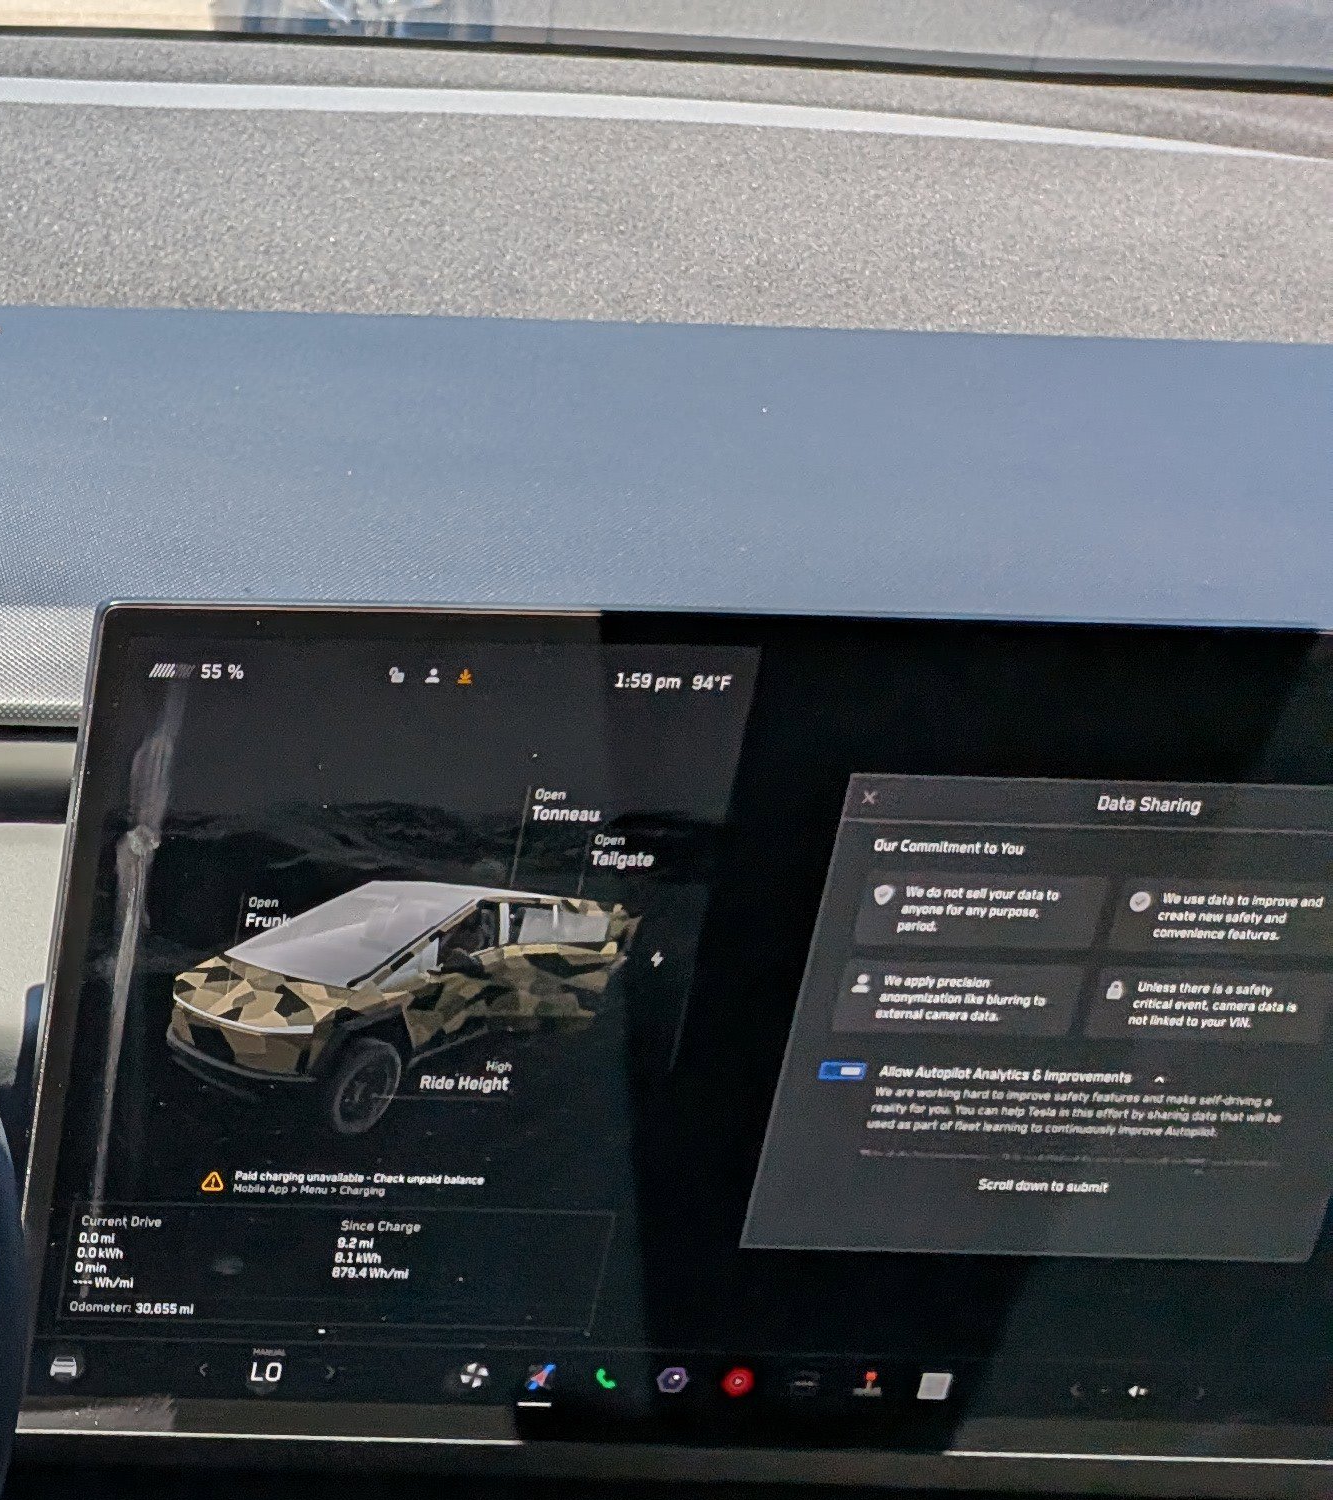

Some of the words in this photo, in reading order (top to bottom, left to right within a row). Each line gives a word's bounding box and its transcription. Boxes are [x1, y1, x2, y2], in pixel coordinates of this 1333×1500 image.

[200, 663, 222, 680] 55
[227, 663, 244, 680] %
[614, 672, 652, 689] 1:59
[654, 676, 682, 692] pm
[692, 674, 732, 691] 94°F
[534, 788, 567, 802] Open
[1096, 794, 1136, 812] Data
[1139, 796, 1202, 816] Sharing
[532, 805, 601, 822] Tonneau
[594, 834, 626, 848] Open
[874, 838, 899, 852] Our
[900, 839, 982, 854] Commitment
[984, 842, 998, 854] to
[1000, 842, 1026, 855] You
[591, 850, 655, 870] Tailgate
[906, 886, 924, 898] We
[926, 887, 942, 898] do
[943, 887, 964, 899] not
[965, 887, 988, 899] sell
[989, 889, 1016, 901] your
[1017, 889, 1044, 901] data
[1046, 890, 1060, 901] to
[1163, 893, 1182, 905] We
[1183, 894, 1206, 905] use
[1207, 894, 1234, 906] data
[1237, 895, 1250, 906] to
[1251, 896, 1299, 908] improve
[1300, 896, 1324, 908] and
[248, 896, 280, 910] Open
[901, 904, 944, 917] anyone
[945, 904, 964, 916] for
[965, 906, 986, 918] any
[1157, 911, 1196, 922] create
[1198, 912, 1224, 922] new
[1225, 912, 1263, 926] safety
[1264, 912, 1288, 924] and
[1152, 927, 1226, 940] convenience
[884, 975, 903, 986] We
[904, 976, 935, 989] apply
[936, 976, 991, 989] precision
[1138, 981, 1176, 994] Unless
[1179, 982, 1210, 994] there
[1212, 983, 1223, 994] is
[1224, 985, 1234, 994] a
[1235, 984, 1273, 997] safety
[879, 993, 962, 1004] anonymization
[964, 993, 984, 1004] like
[986, 994, 1031, 1008] blurring
[1033, 995, 1046, 1007] to
[1132, 999, 1172, 1010] critical
[1212, 1001, 1256, 1012] camera
[1258, 1002, 1284, 1012] data
[1286, 1002, 1297, 1013] is
[875, 1008, 924, 1020] external
[925, 1010, 968, 1021] camera
[1128, 1015, 1147, 1026] not
[1150, 1015, 1184, 1026] linked
[1186, 1016, 1198, 1026] to
[1200, 1018, 1226, 1029] your
[486, 1060, 512, 1074] High
[879, 1065, 913, 1078] Allow
[914, 1066, 972, 1080] Autopilot
[972, 1066, 1030, 1082] Analytics
[1044, 1070, 1132, 1084] Improvements
[419, 1074, 455, 1090] Ride
[458, 1075, 510, 1094] Height
[234, 1170, 258, 1182] Paid
[259, 1171, 305, 1184] charging
[306, 1172, 364, 1184] unavailable
[373, 1173, 405, 1184] Check
[407, 1174, 443, 1186] unpaid
[444, 1174, 486, 1186] balance
[233, 1183, 266, 1194] Mobile
[268, 1184, 289, 1196] App
[299, 1184, 328, 1195] Menu
[339, 1185, 386, 1198] Charging
[978, 1178, 1014, 1190] Scroll
[1015, 1180, 1048, 1192] down
[1051, 1180, 1064, 1192] to
[1066, 1181, 1110, 1194] submit
[81, 1214, 128, 1228] Current
[130, 1216, 162, 1228] Drive
[341, 1220, 374, 1232] Since
[377, 1220, 422, 1235] Charge
[79, 1232, 99, 1244] 0.0
[100, 1232, 116, 1244] mi
[358, 1238, 375, 1249] mi
[76, 1246, 96, 1258] 0.0
[98, 1247, 124, 1260] kWh
[356, 1252, 382, 1264] kWh
[74, 1262, 84, 1273] 0
[85, 1262, 108, 1274] min
[94, 1276, 134, 1289] Wh/mi
[69, 1300, 132, 1313] Odometer:
[178, 1304, 194, 1316] mi
[250, 1362, 283, 1382] LO
